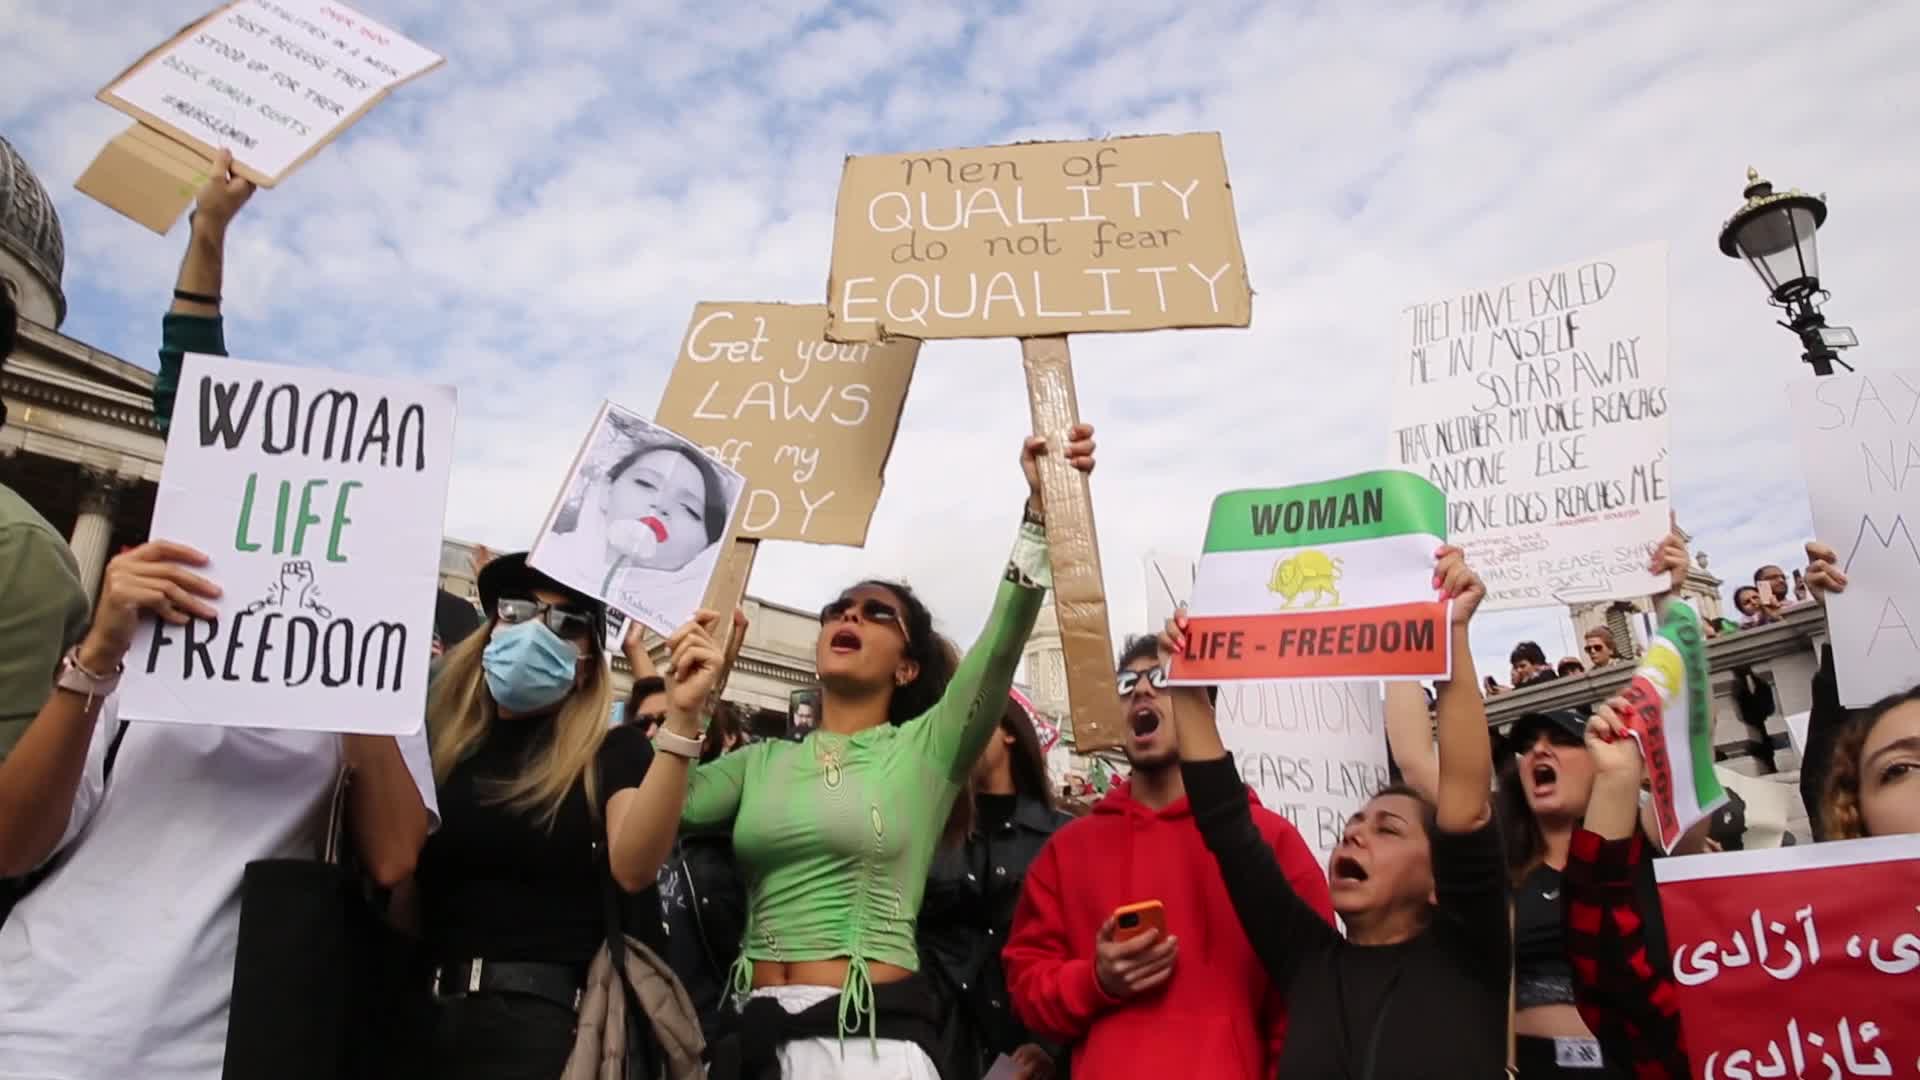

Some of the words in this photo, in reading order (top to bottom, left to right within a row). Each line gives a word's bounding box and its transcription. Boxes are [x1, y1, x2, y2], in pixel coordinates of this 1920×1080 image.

[1061, 147, 1119, 187] of
[867, 178, 1200, 232] QUALITY
[891, 227, 949, 265] do
[984, 222, 1062, 258] not
[1092, 221, 1182, 259] fear
[842, 262, 1231, 327] EQUALITY
[1461, 282, 1522, 334] HAVE
[1528, 260, 1616, 319] EXILED
[686, 311, 770, 365] Get
[779, 339, 870, 384] your
[1410, 346, 1439, 387] ME
[1449, 335, 1474, 378] IN
[1489, 310, 1580, 368] MYSELF
[1472, 370, 1514, 413] SO
[1515, 357, 1563, 403] FAR
[1572, 335, 1641, 393] AWAY
[199, 375, 425, 472] WOMAN
[692, 379, 872, 427] LAWS
[773, 444, 820, 483] my
[1393, 422, 1432, 465] THAT
[1508, 406, 1530, 443] MY
[1535, 433, 1590, 478] ELSE
[234, 472, 363, 563] LIFE
[741, 488, 836, 535] DY
[1250, 486, 1385, 538] WOMAN
[145, 608, 408, 693] FREEDOM
[1184, 630, 1246, 661] LIFE
[1278, 618, 1436, 658] FREEDOM
[1237, 750, 1315, 793] EARS
[1672, 903, 1821, 986] آزادی
